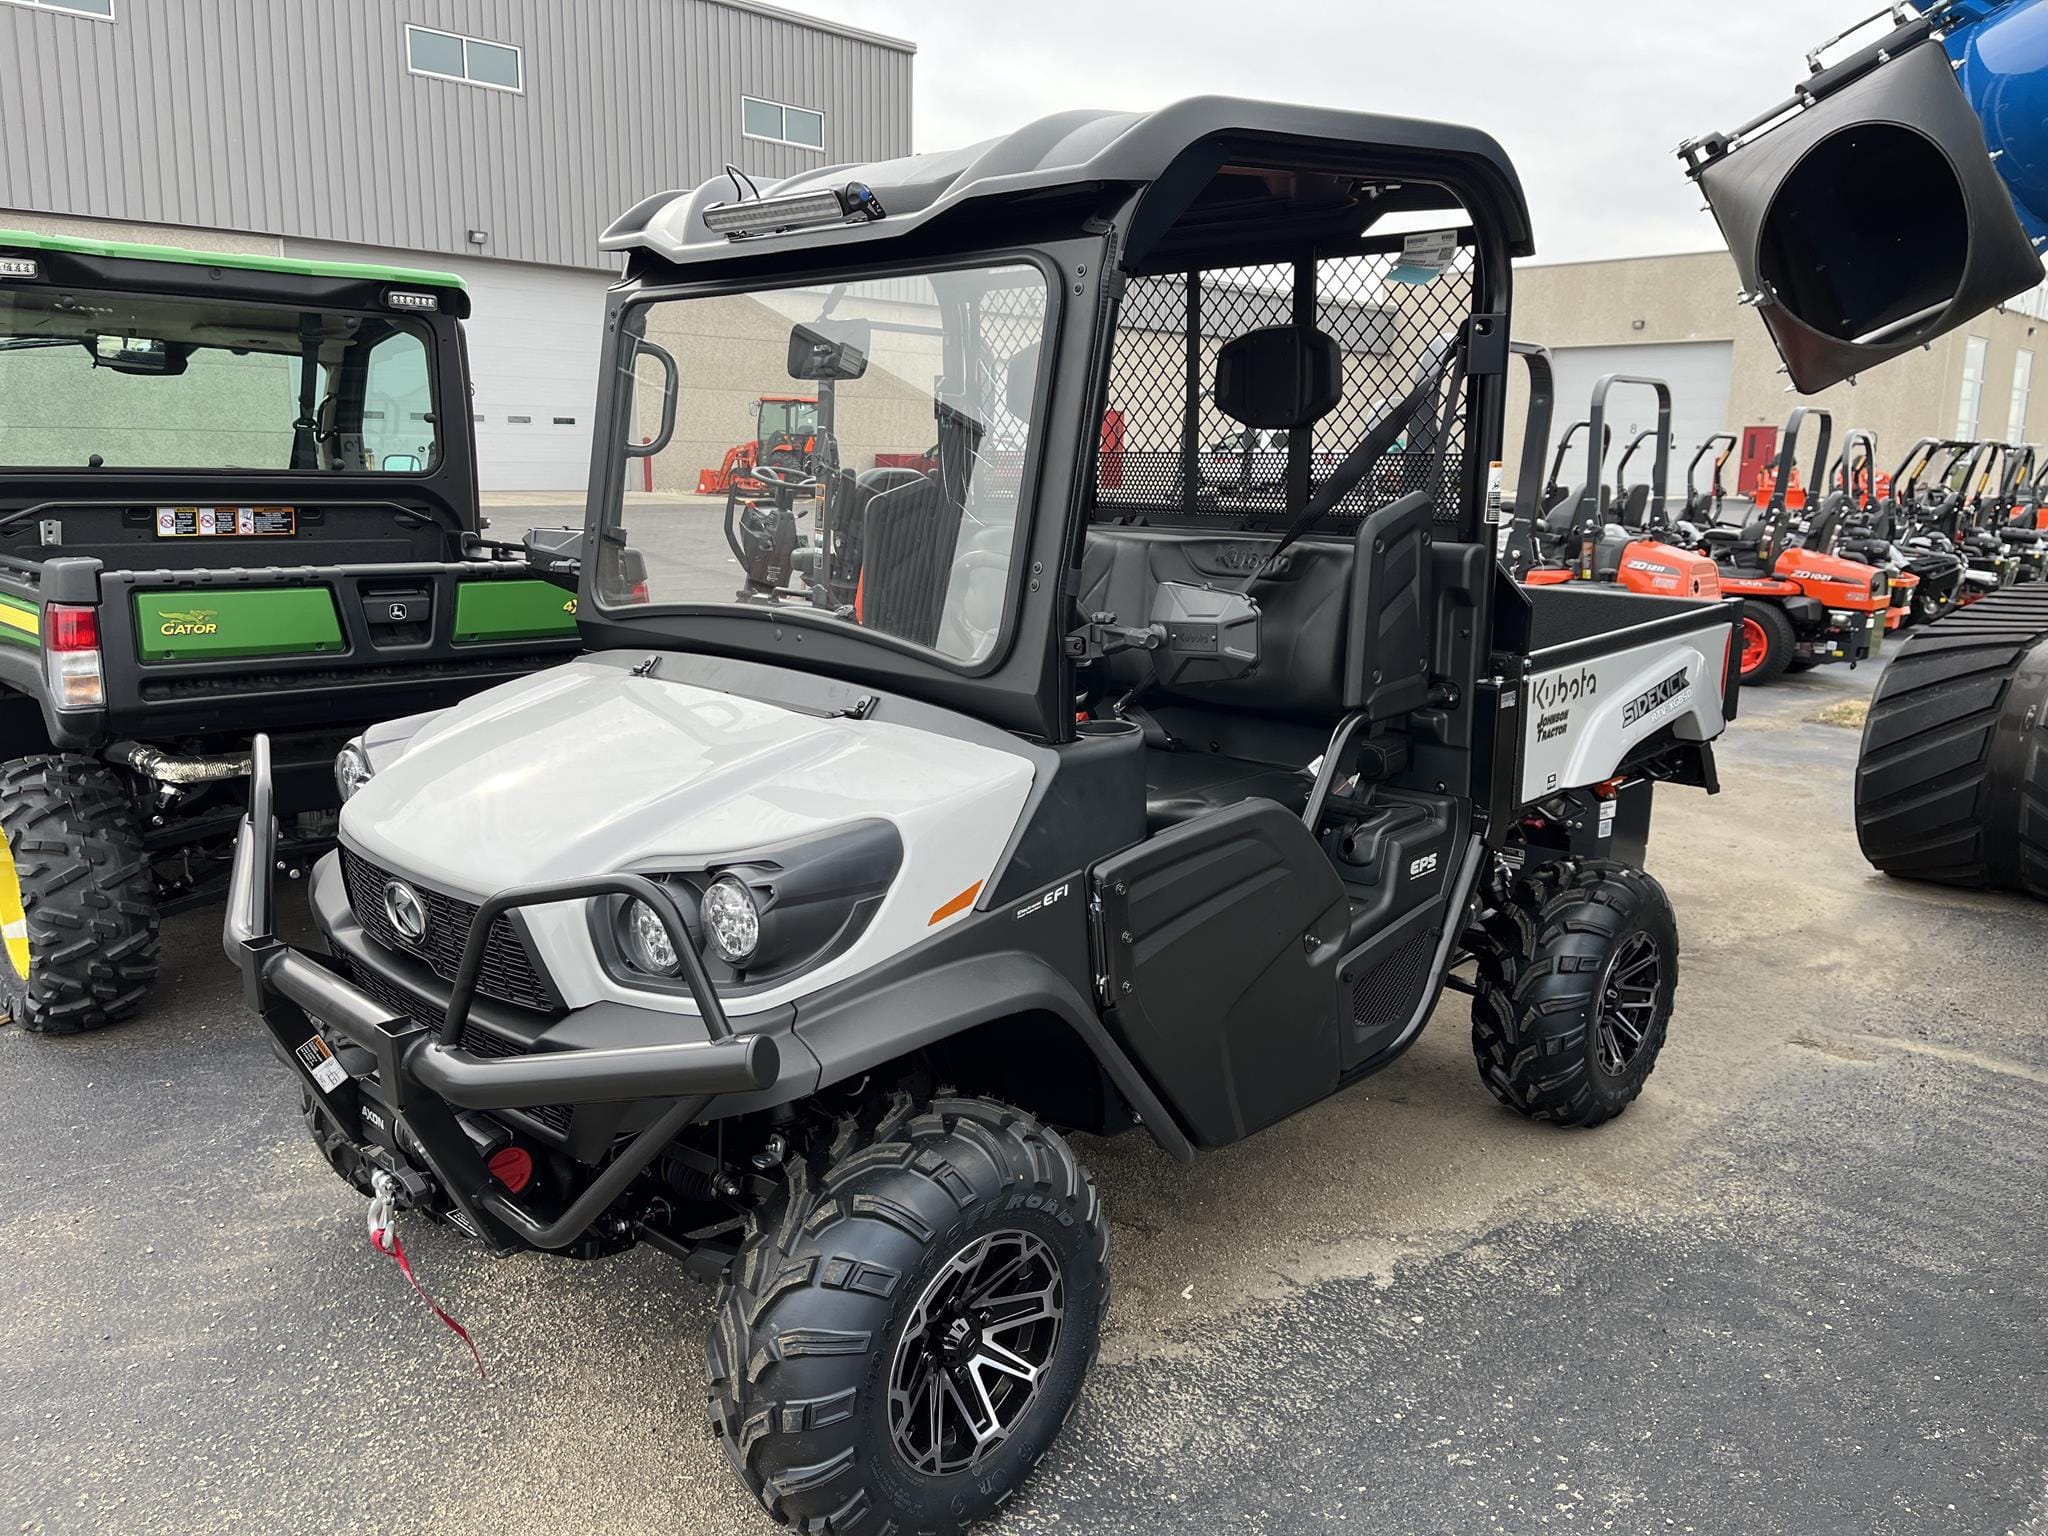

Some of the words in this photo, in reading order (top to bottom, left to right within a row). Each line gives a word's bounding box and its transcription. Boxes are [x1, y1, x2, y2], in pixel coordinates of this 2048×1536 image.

[160, 622, 217, 636] GATOR
[1532, 667, 1597, 710] Kubota
[1622, 665, 1690, 729] SIDEKICK
[1537, 709, 1570, 729] JOHNSON
[1651, 708, 1668, 722] RTV
[1537, 723, 1568, 743] TRACTOR
[1410, 852, 1438, 875] EPS
[1043, 884, 1069, 907] EFI
[361, 1105, 385, 1130] AXON
[1003, 1193, 1075, 1228] ROAD
